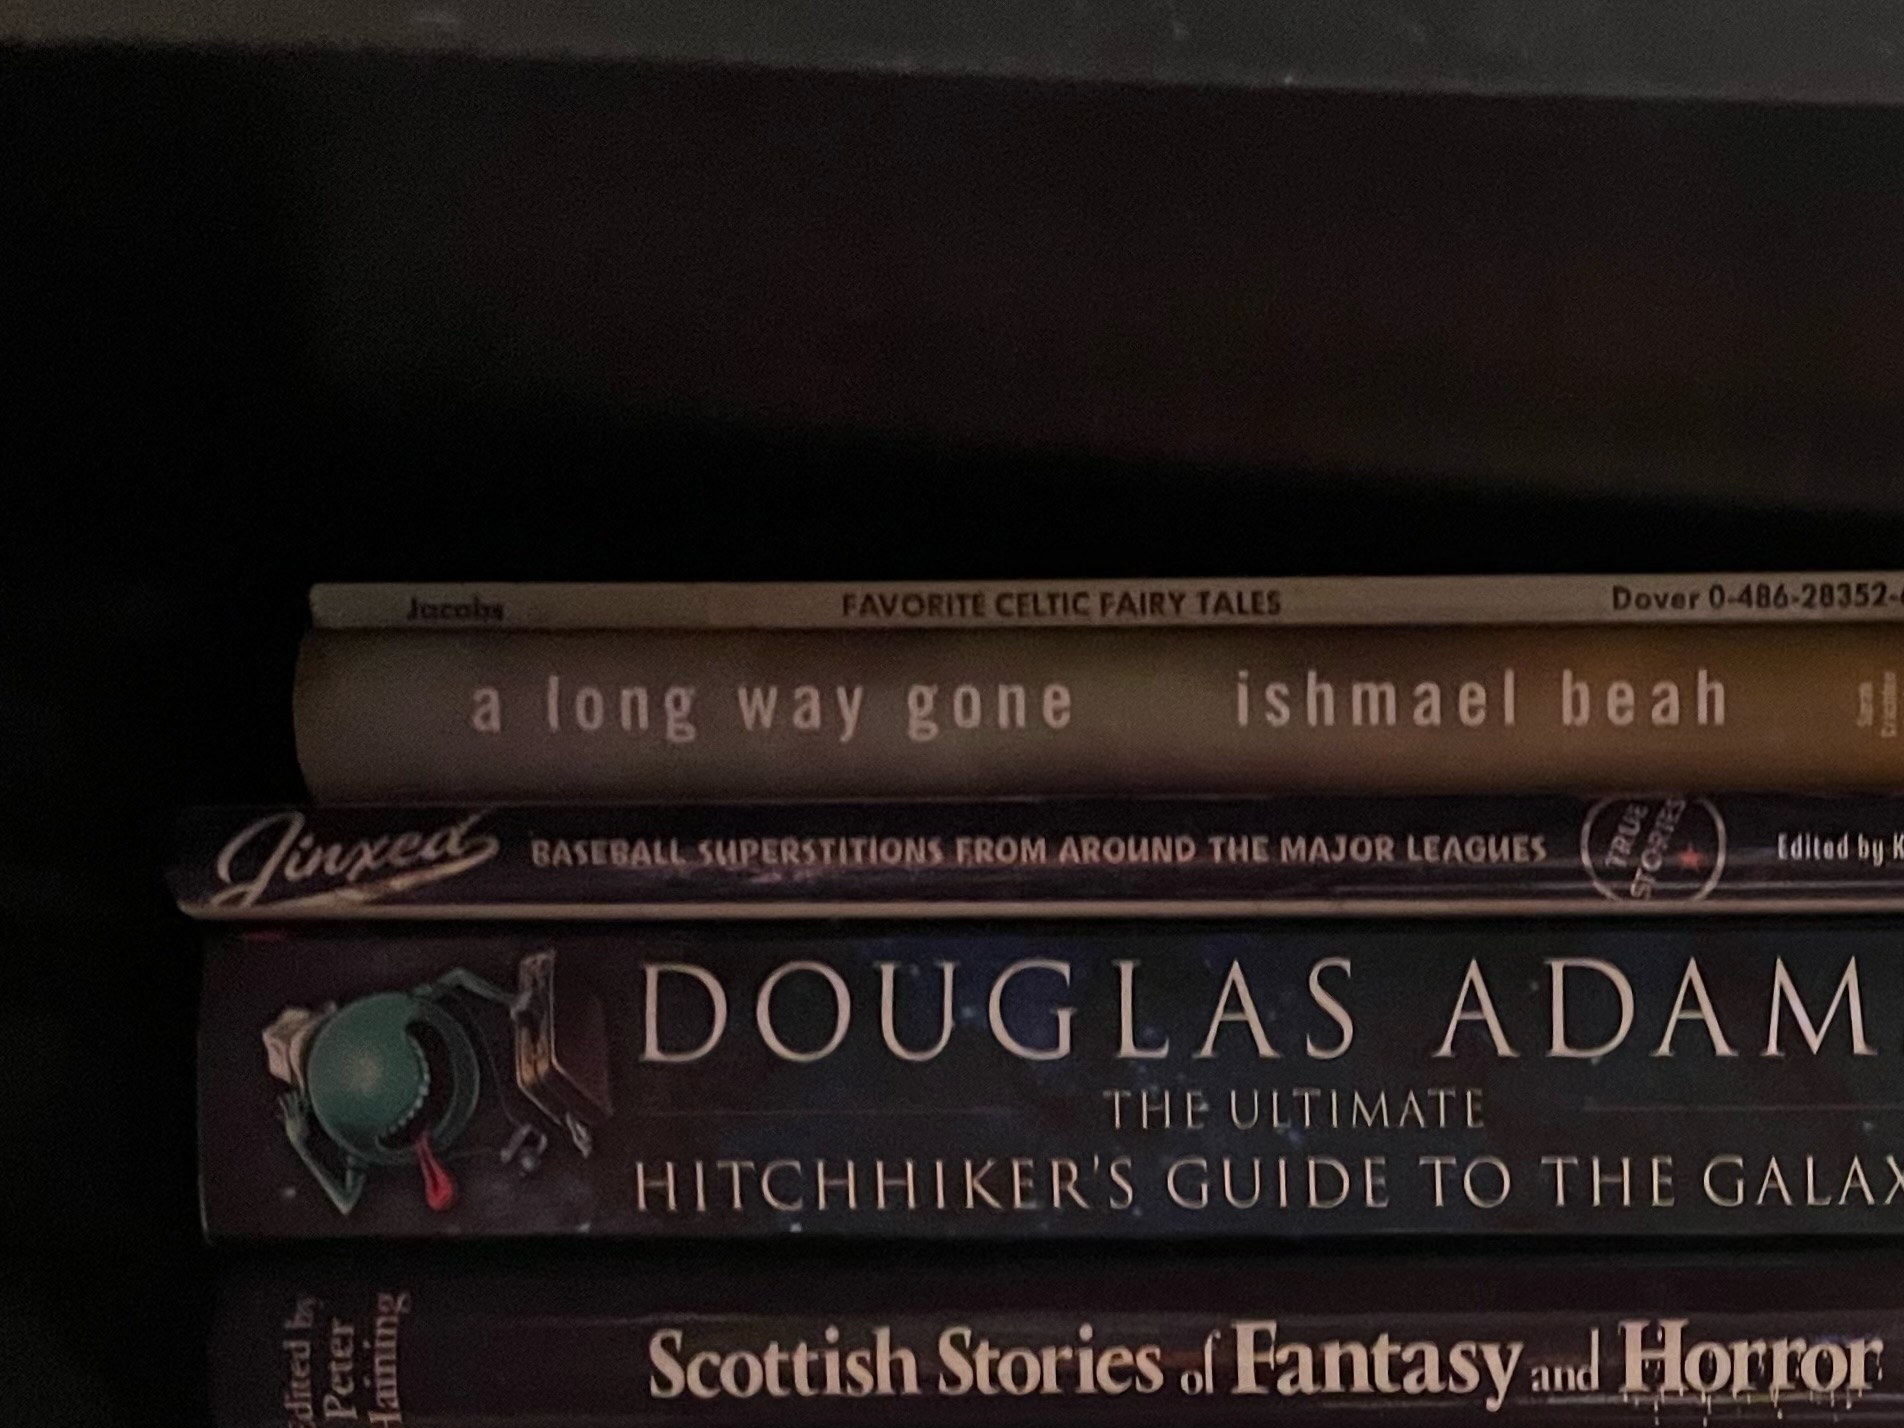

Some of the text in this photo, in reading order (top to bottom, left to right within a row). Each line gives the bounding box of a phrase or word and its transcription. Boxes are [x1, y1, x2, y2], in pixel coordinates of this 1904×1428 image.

[407, 598, 503, 622] Jacobs
[841, 590, 1282, 619] FAVORITE CELTIC FAIRY TALES
[1612, 585, 1700, 611] Dover
[472, 675, 1073, 744] a long way gone
[1236, 668, 1726, 728] ishmael beah
[208, 805, 500, 908] Jinxed
[531, 834, 1548, 868] BASEBALL SUPERSTITIONS FROM AROUND THE MAJOR LEAGUES
[1776, 832, 1850, 861] Edited
[1858, 832, 1886, 867] by
[638, 956, 1357, 1065] DOUGLAS
[1103, 1087, 1485, 1131] THE ULTIMATE
[636, 1153, 1135, 1212] HITCHHIKER'S
[1166, 1156, 1388, 1211] GUIDE
[1418, 1154, 1511, 1209] TO
[1540, 1153, 1674, 1207] THE
[322, 1318, 357, 1422] Peter
[648, 1318, 1884, 1412] Scottish Stories of Fantasy and Horror
